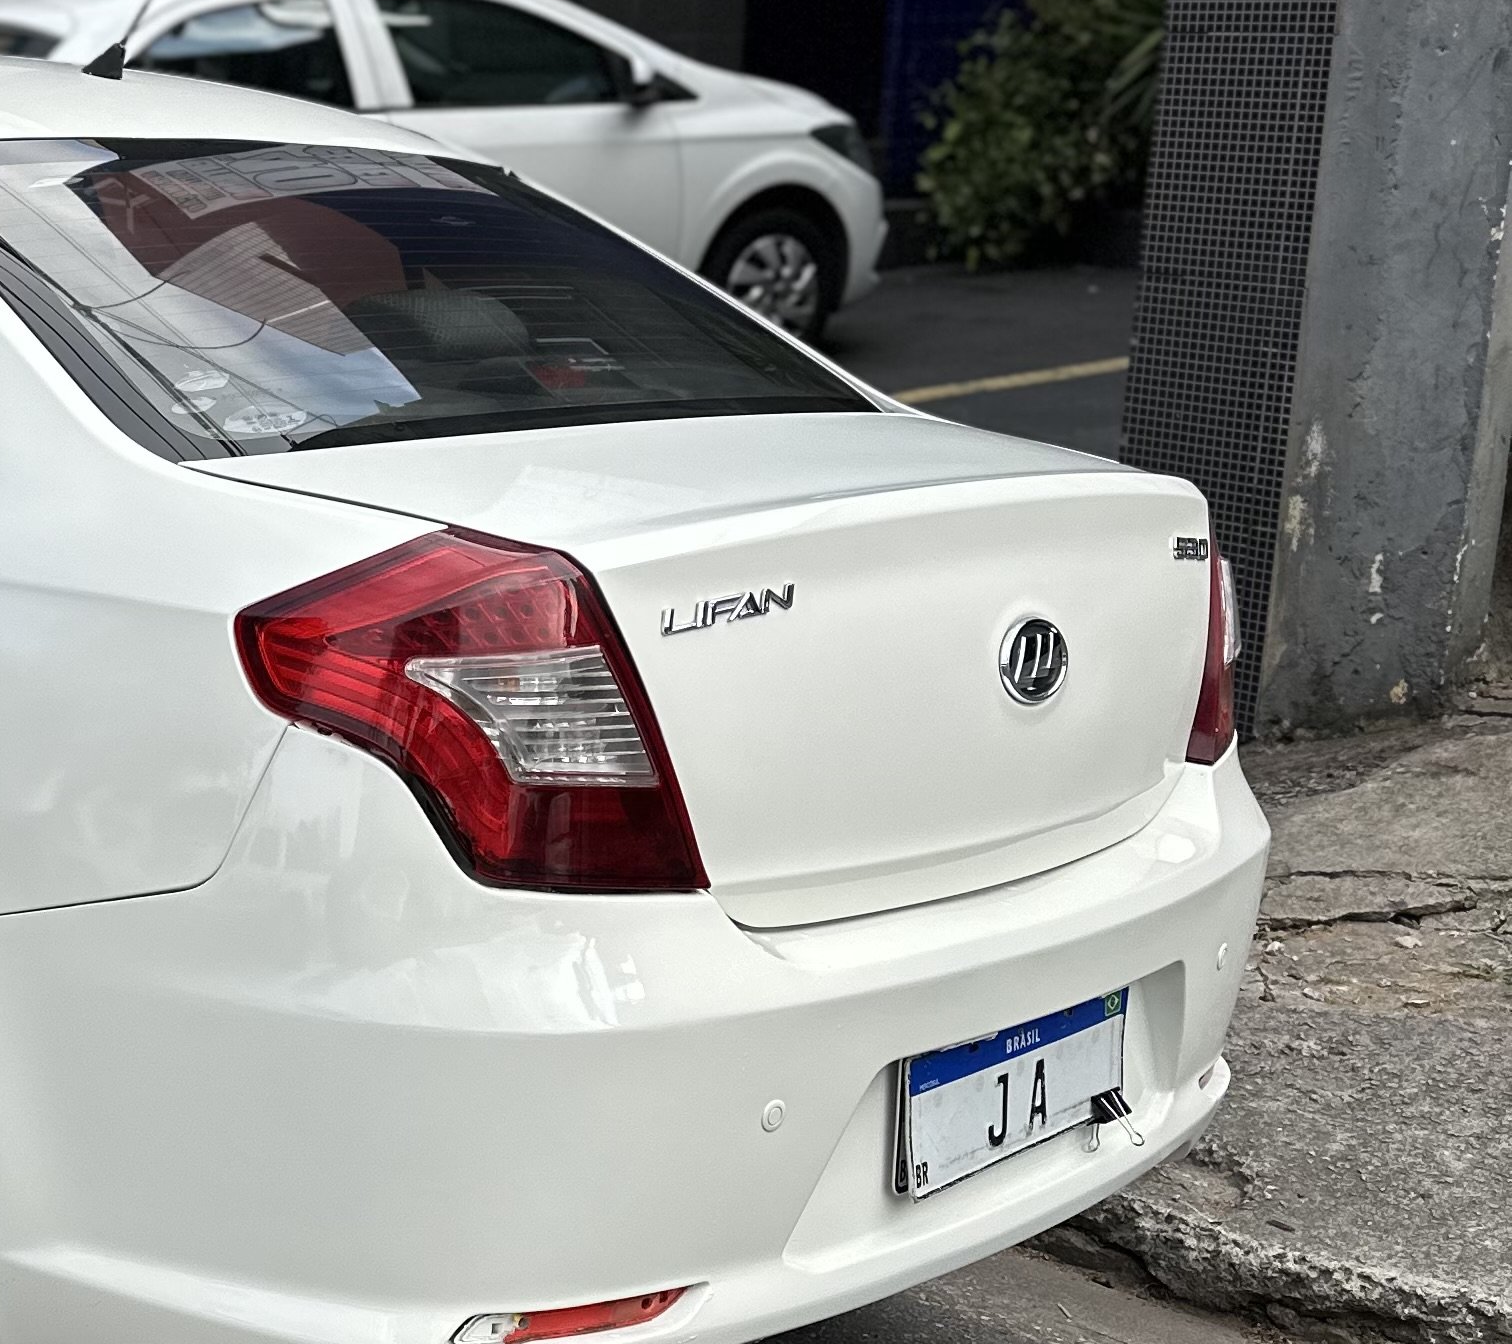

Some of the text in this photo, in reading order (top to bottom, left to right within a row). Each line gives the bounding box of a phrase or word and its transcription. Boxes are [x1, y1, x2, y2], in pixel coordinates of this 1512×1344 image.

[660, 583, 796, 637] LIFAN
[1006, 1028, 1041, 1054] BRASIL
[915, 1161, 929, 1188] BR
